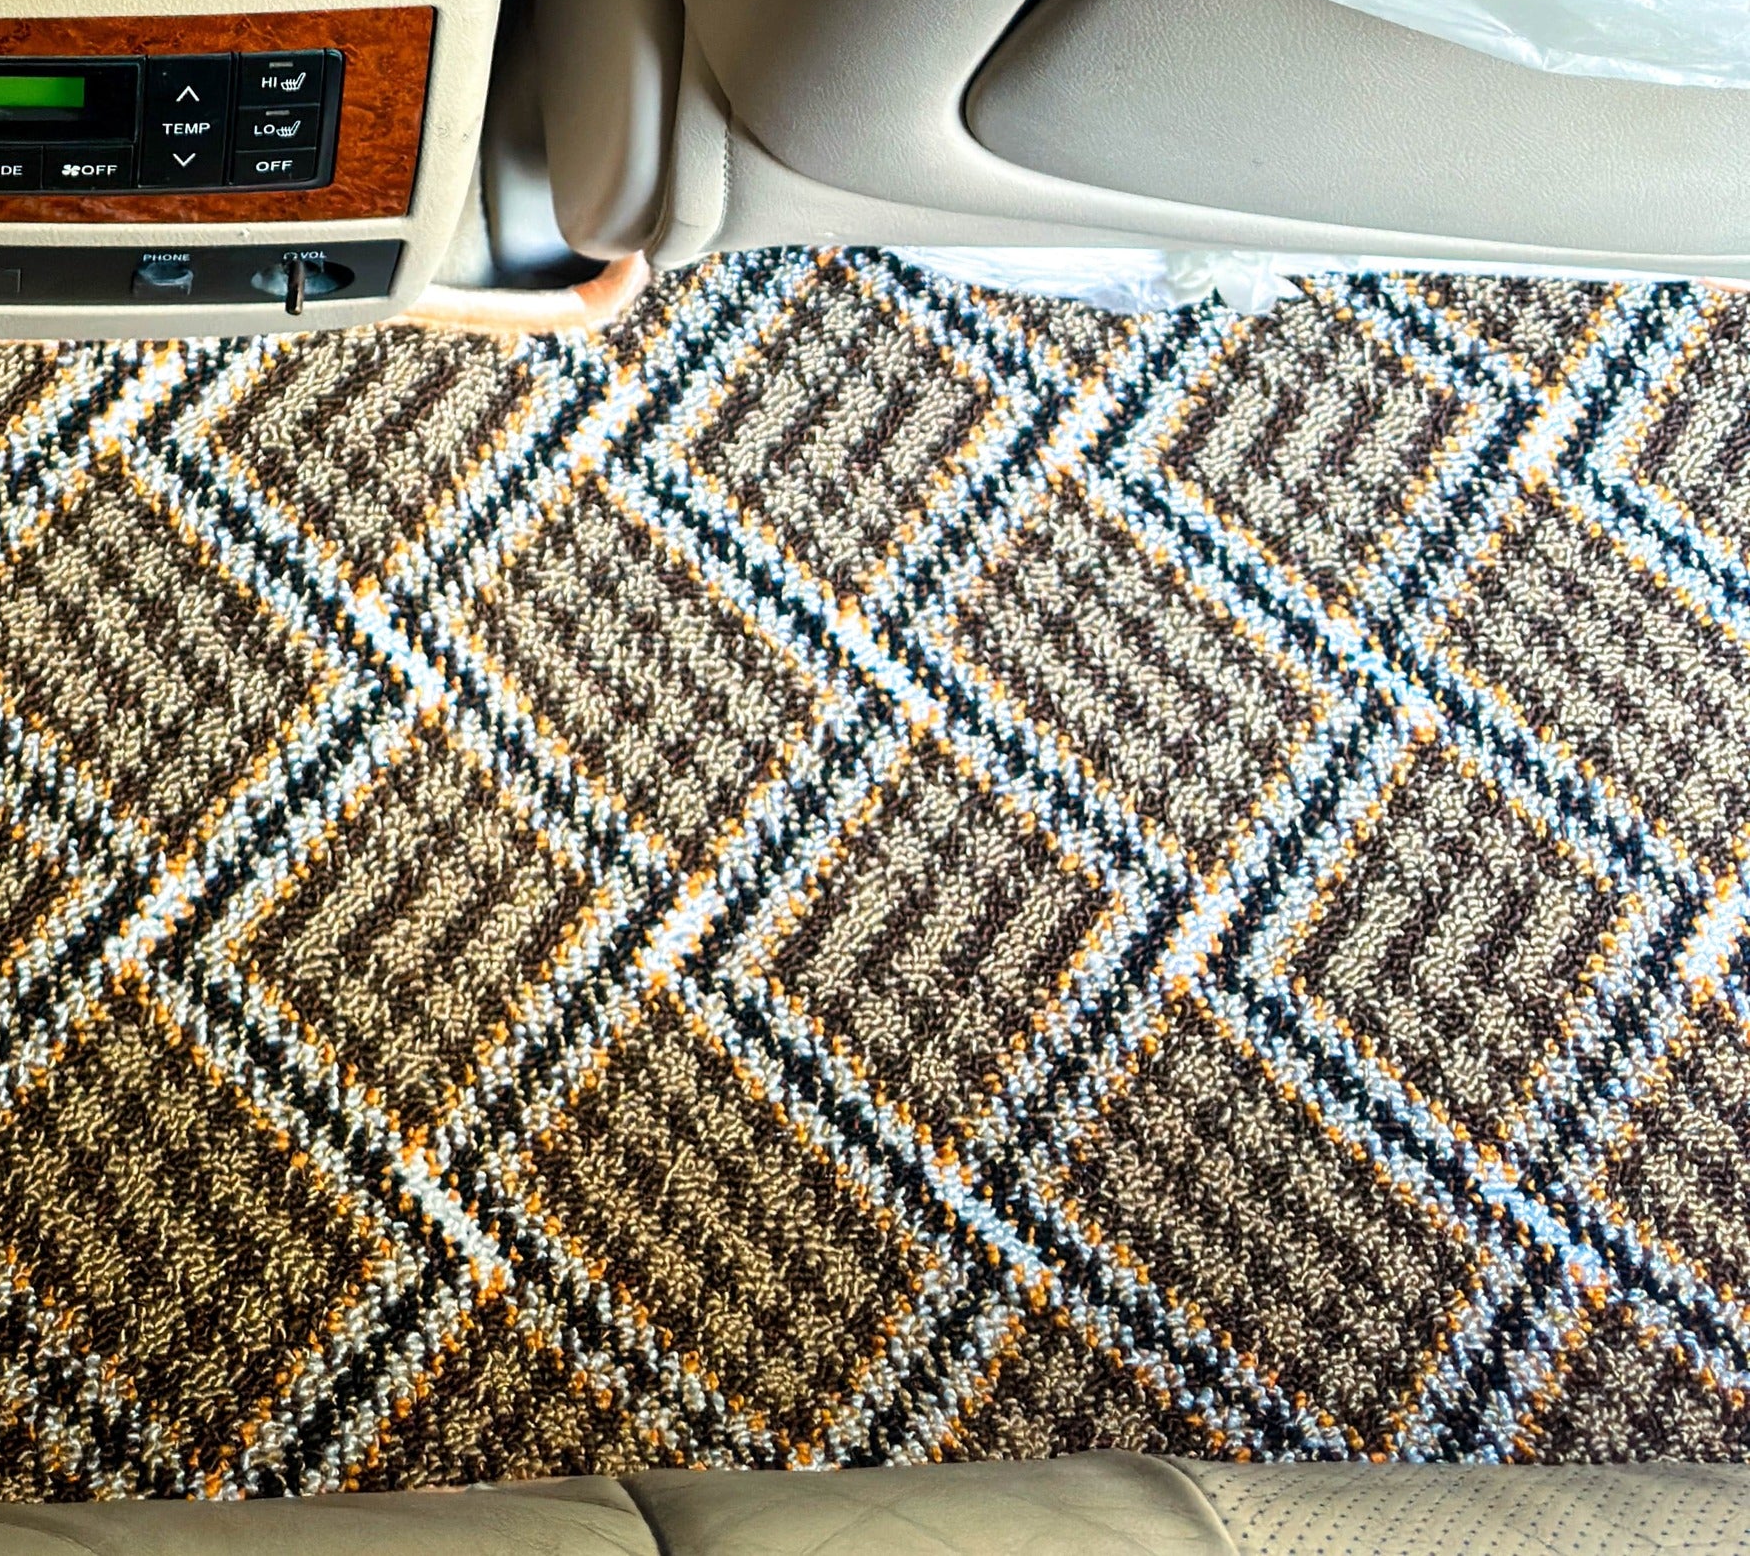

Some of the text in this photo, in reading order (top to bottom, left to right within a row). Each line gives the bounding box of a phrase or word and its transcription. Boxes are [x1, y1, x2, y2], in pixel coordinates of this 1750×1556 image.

[261, 76, 278, 89] HI
[162, 122, 211, 136] TEMP
[253, 124, 276, 136] LO
[80, 163, 119, 177] OFF
[255, 159, 294, 174] OFF
[142, 252, 192, 262] PHONE
[300, 250, 328, 260] VOL
